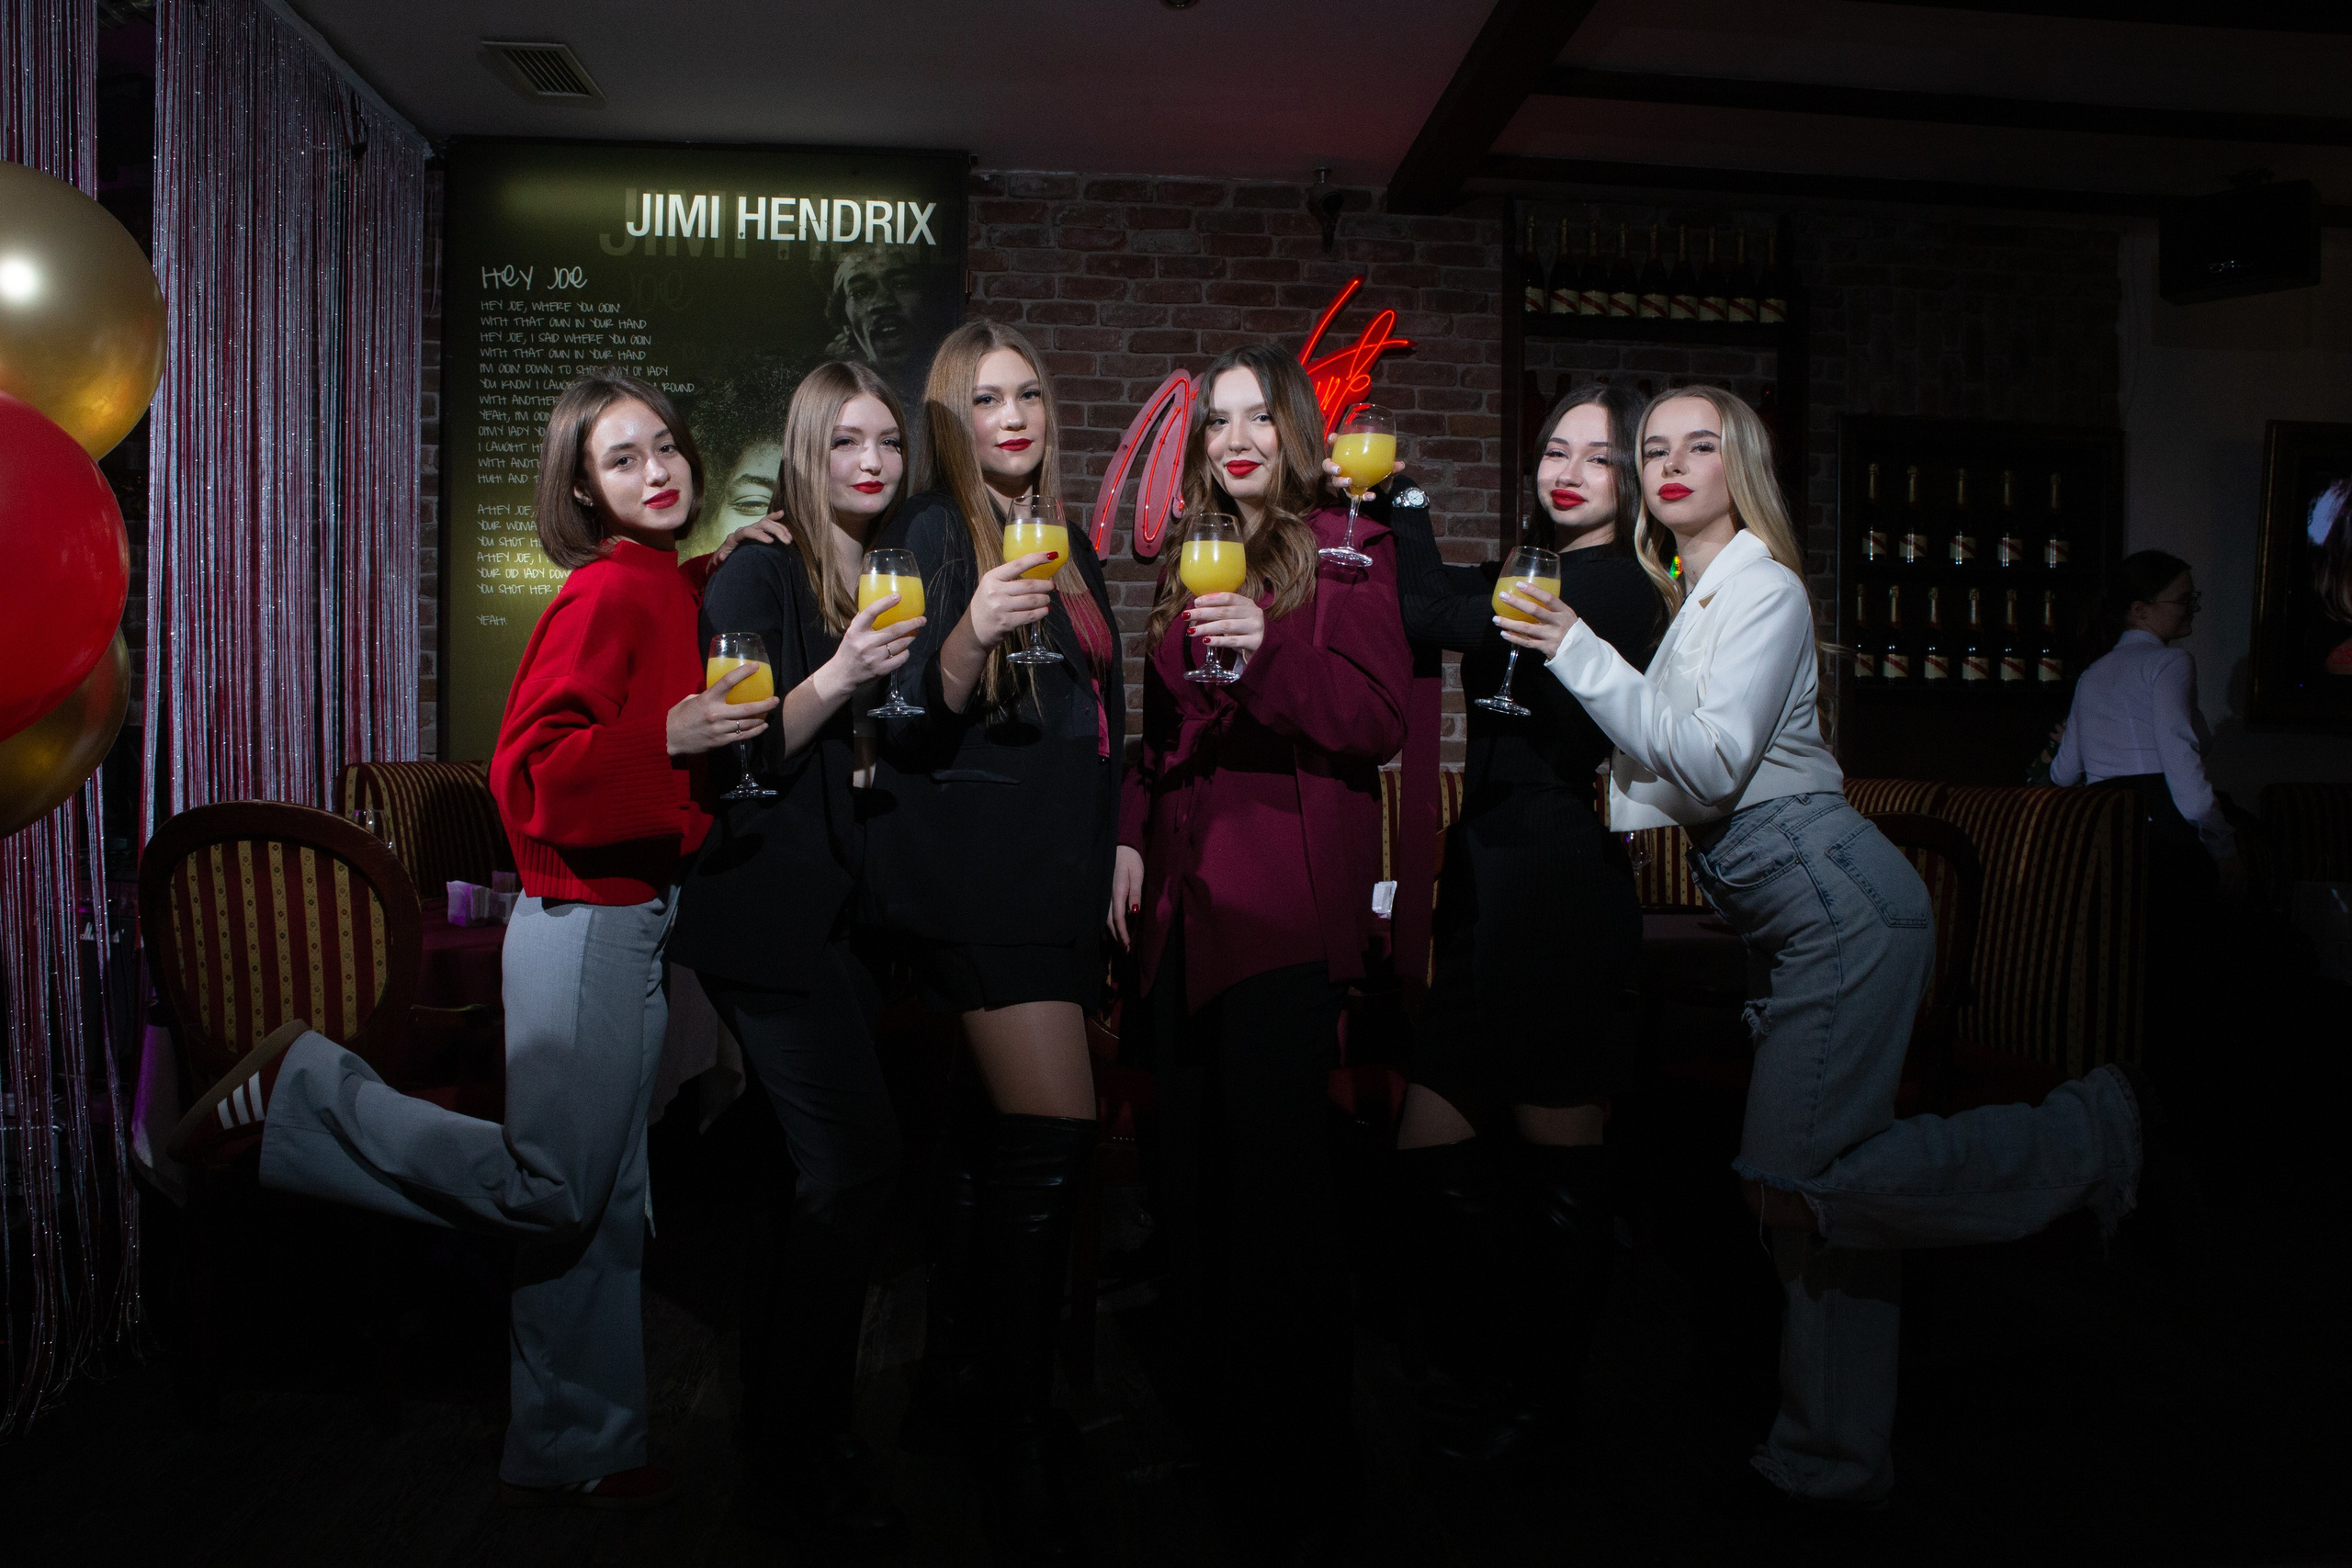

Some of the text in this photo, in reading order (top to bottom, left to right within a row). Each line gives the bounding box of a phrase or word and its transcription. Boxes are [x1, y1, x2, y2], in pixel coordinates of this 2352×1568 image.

[627, 193, 936, 245] JIMI HENDRIX
[481, 300, 503, 310] HEY
[507, 301, 527, 313] JOE,
[532, 301, 571, 311] WHERE
[577, 301, 594, 312] YOU
[481, 316, 647, 329] WITH THAT GUN IN YOUR HAND
[481, 332, 502, 342] HEY
[507, 332, 526, 344] JOE,
[538, 333, 560, 343] SAID
[564, 333, 604, 344] WHERE
[609, 333, 626, 344] YOU
[480, 347, 646, 360] WITH THAT GUN IN YOUR HAND
[525, 364, 553, 374] DOWN
[558, 365, 571, 375] TO
[480, 378, 496, 389] YOU
[501, 379, 531, 389] KNOW
[480, 394, 507, 404] WITH
[479, 409, 510, 423] YEAH,
[534, 425, 546, 436] YO
[485, 442, 527, 452] CAUGHT
[478, 457, 505, 468] WITH
[508, 473, 528, 483] AND
[478, 520, 538, 531] YOUR WOMA
[477, 536, 494, 547] YOU
[499, 536, 526, 547] SHOT
[514, 553, 534, 565] JOE,
[477, 568, 501, 578] YOUR
[477, 583, 493, 593] YOU
[499, 584, 525, 593] SHOT
[530, 584, 552, 594] HER
